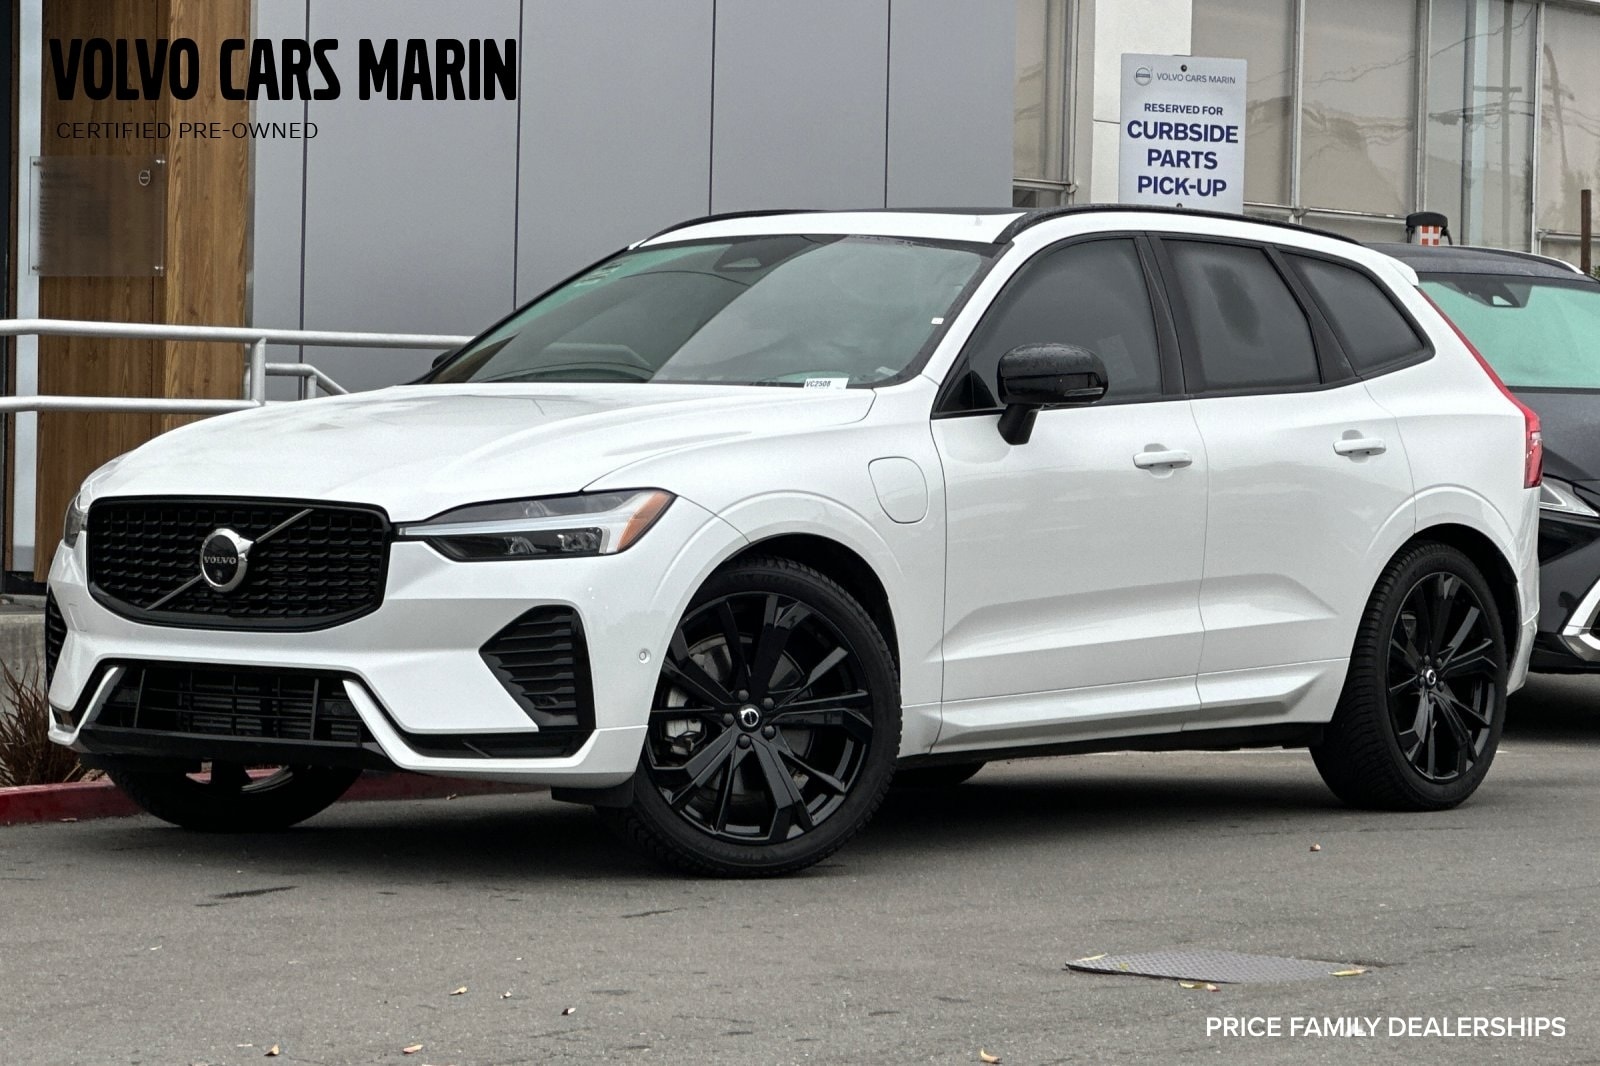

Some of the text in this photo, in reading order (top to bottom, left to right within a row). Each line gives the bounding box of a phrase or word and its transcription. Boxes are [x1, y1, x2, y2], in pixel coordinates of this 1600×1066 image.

[1156, 72, 1236, 85] VOLVO CARS MARIN
[1144, 103, 1224, 116] RESERVED FOR
[1127, 120, 1239, 144] CURBSIDE
[1147, 148, 1218, 170] PARTS
[1137, 175, 1227, 197] PICK-UP
[203, 556, 237, 564] VOLVO
